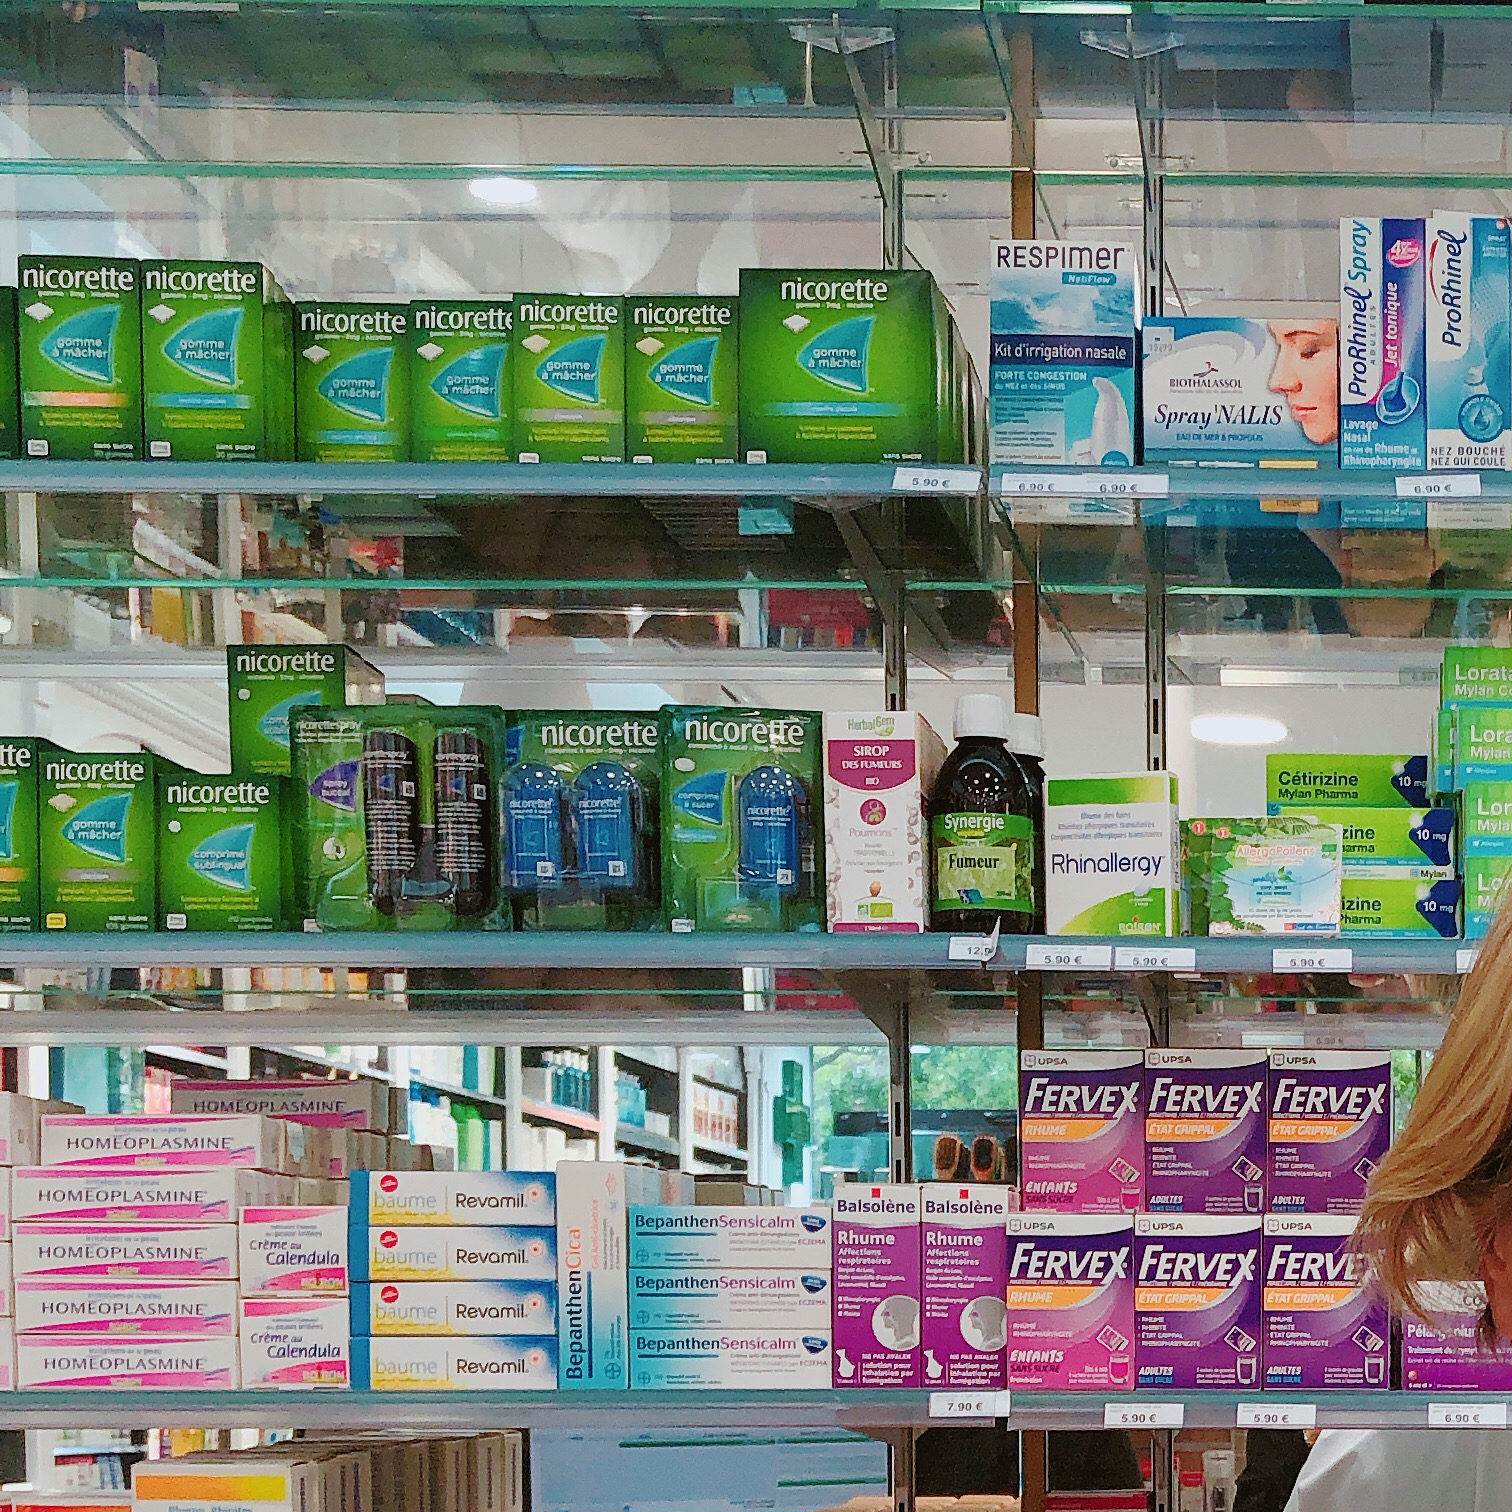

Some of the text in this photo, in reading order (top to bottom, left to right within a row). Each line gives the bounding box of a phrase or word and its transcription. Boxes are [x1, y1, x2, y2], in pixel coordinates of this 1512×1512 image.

[23, 266, 134, 292] nicorette
[781, 278, 887, 302] nicorette
[1441, 230, 1467, 348] ProRhinel
[520, 302, 617, 325] nicorette
[1348, 220, 1373, 397] ProRhinel Spray
[301, 311, 406, 335] nicorette
[1382, 281, 1399, 367] Jet tonique
[57, 337, 102, 349] gomme
[64, 345, 107, 359] mâcher
[994, 342, 1126, 362] Kit d'irrigation nasale
[1170, 378, 1242, 389] BIOTHALASSOL
[1154, 404, 1282, 429] Spray'NALIS
[1455, 684, 1495, 698] Mylan
[854, 744, 890, 758] SIROP
[46, 759, 145, 782] nicorette
[1278, 770, 1359, 788] Cétirizine
[1278, 788, 1358, 800] Mylan Pharma
[944, 815, 1004, 832] Synergie
[948, 853, 999, 870] Fumeur
[1051, 854, 1162, 876] Rhinallergy
[1044, 955, 1082, 966] 5.90 €
[1286, 1056, 1316, 1066] UPSA
[1025, 1078, 1140, 1118] FERVEX
[1149, 1078, 1264, 1118] FERVEX
[1272, 1079, 1387, 1118] FERVEX
[1025, 1124, 1067, 1137] RHUME
[374, 1190, 526, 1209] baume Revamil
[837, 1198, 915, 1214] Balsolène
[635, 1213, 795, 1231] BepanthenSensicalm
[249, 1239, 287, 1251] Crème
[838, 1231, 895, 1246] Rhume
[266, 1250, 339, 1266] Calendula
[566, 1229, 584, 1380] BepanthenCica
[975, 1402, 983, 1412] €
[1471, 1414, 1480, 1423] €
